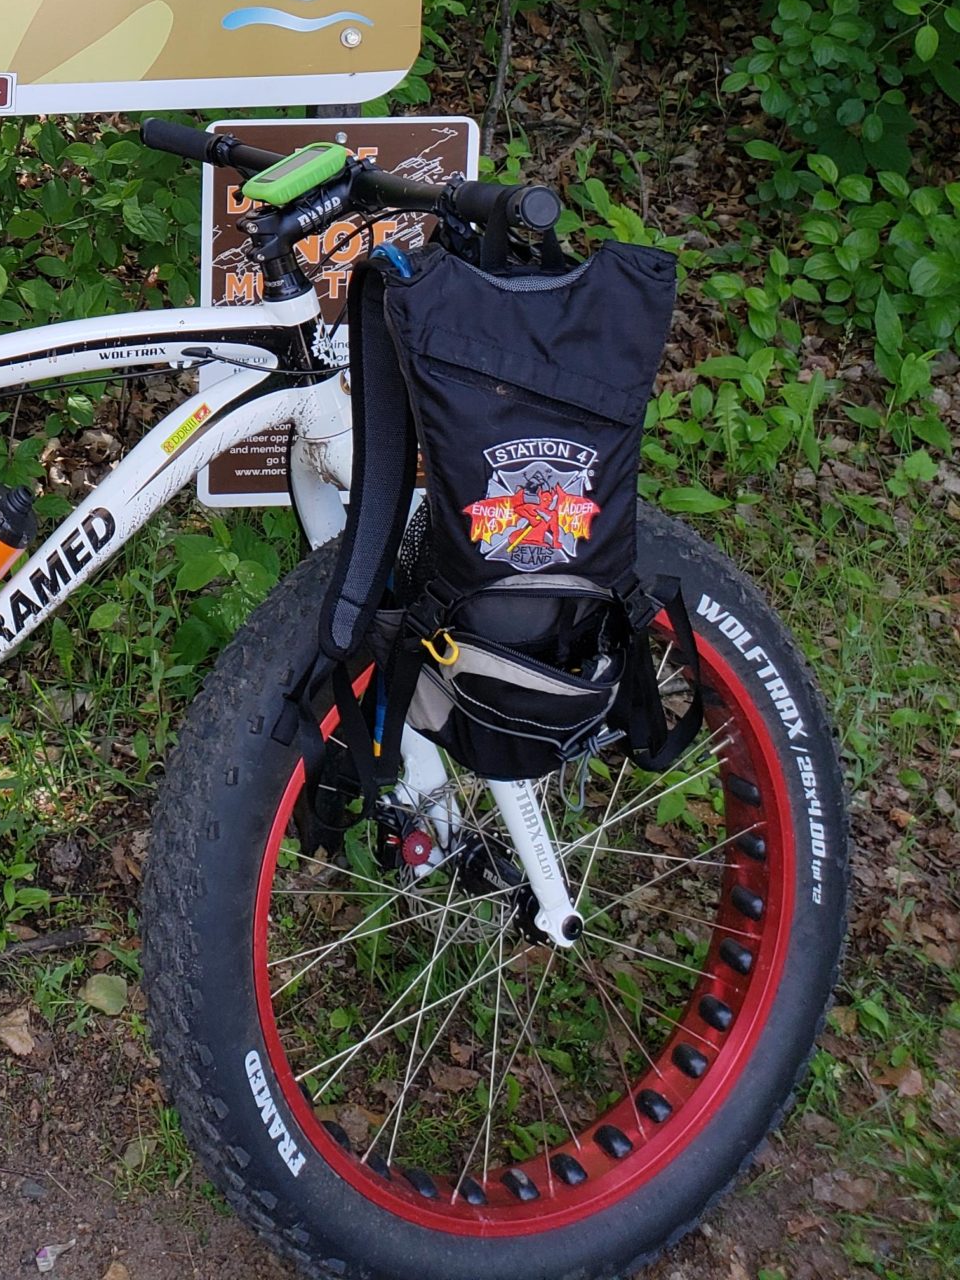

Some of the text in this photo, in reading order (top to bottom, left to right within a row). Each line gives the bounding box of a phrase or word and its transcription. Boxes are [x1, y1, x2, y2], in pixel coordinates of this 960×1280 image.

[98, 346, 167, 360] WOLFTRAX
[495, 441, 588, 463] STATION 4
[472, 505, 515, 520] ENGINE
[559, 503, 594, 515] LADDER
[510, 554, 552, 566] ISLAND
[696, 593, 807, 741] WOLFTRAX
[244, 1049, 307, 1178] FRAMED
